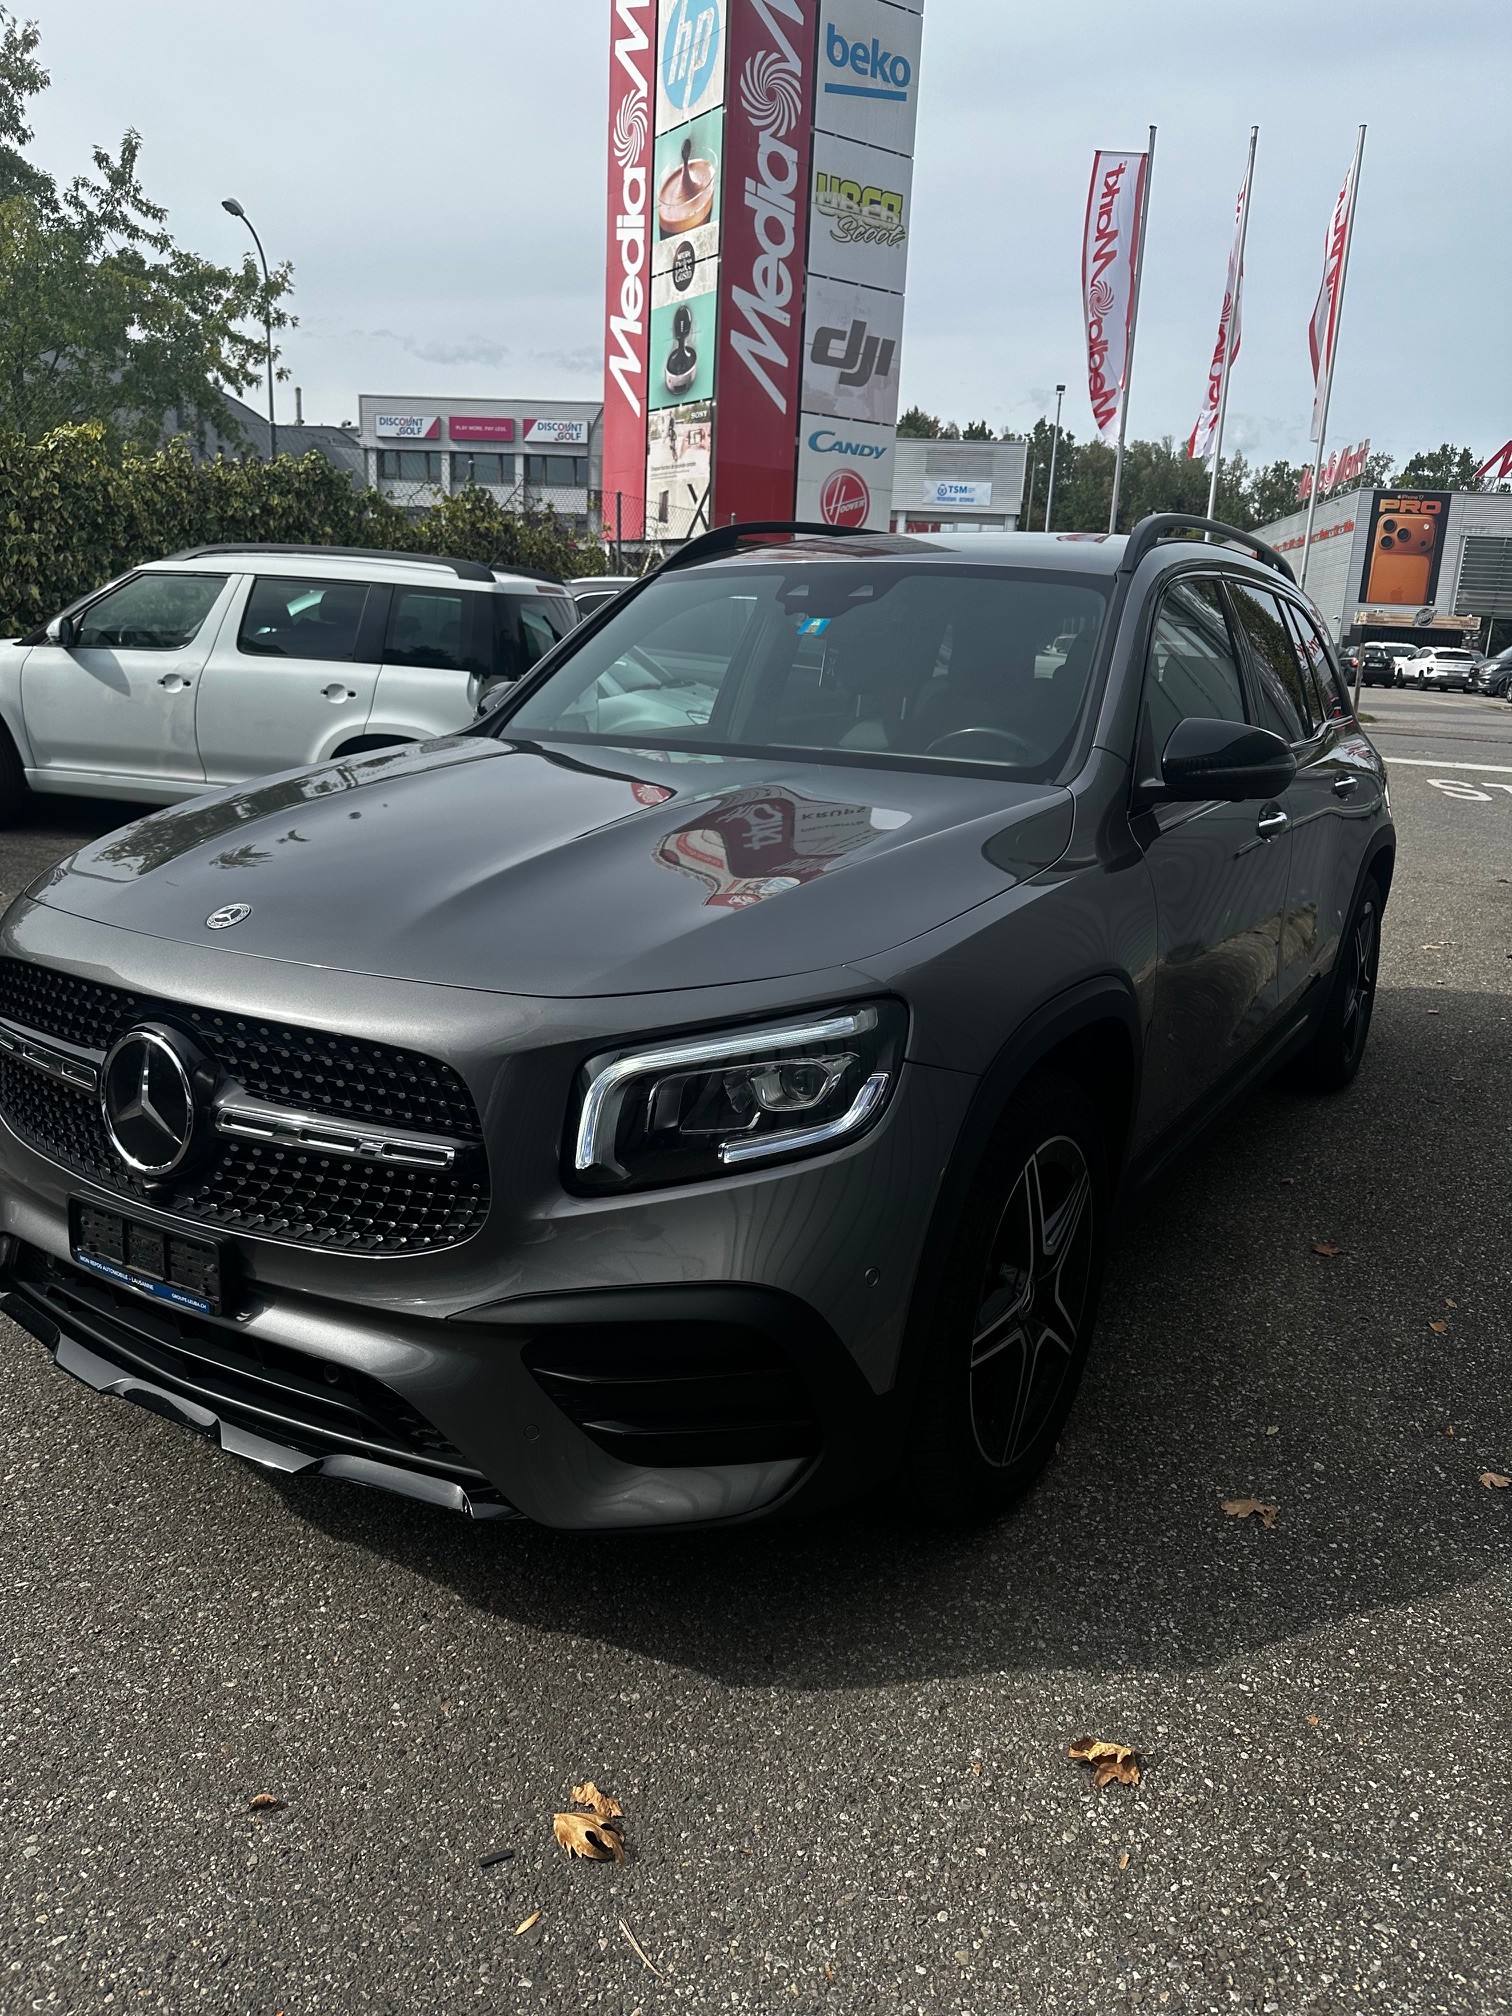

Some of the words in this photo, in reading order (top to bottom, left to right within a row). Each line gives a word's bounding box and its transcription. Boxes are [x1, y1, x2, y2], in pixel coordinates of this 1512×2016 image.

[668, 0, 715, 109] hp
[826, 22, 911, 88] beko
[816, 172, 904, 226] UBER
[730, 130, 799, 415] Media
[609, 166, 646, 418] Media
[379, 416, 424, 427] DISCOUNT
[691, 410, 708, 420] SONY
[399, 426, 423, 436] GOLF
[537, 421, 583, 432] DISCOUNT
[557, 431, 582, 442] GOLF
[808, 430, 887, 460] CANDY
[948, 485, 968, 494] TSM
[1379, 499, 1442, 514] PRO
